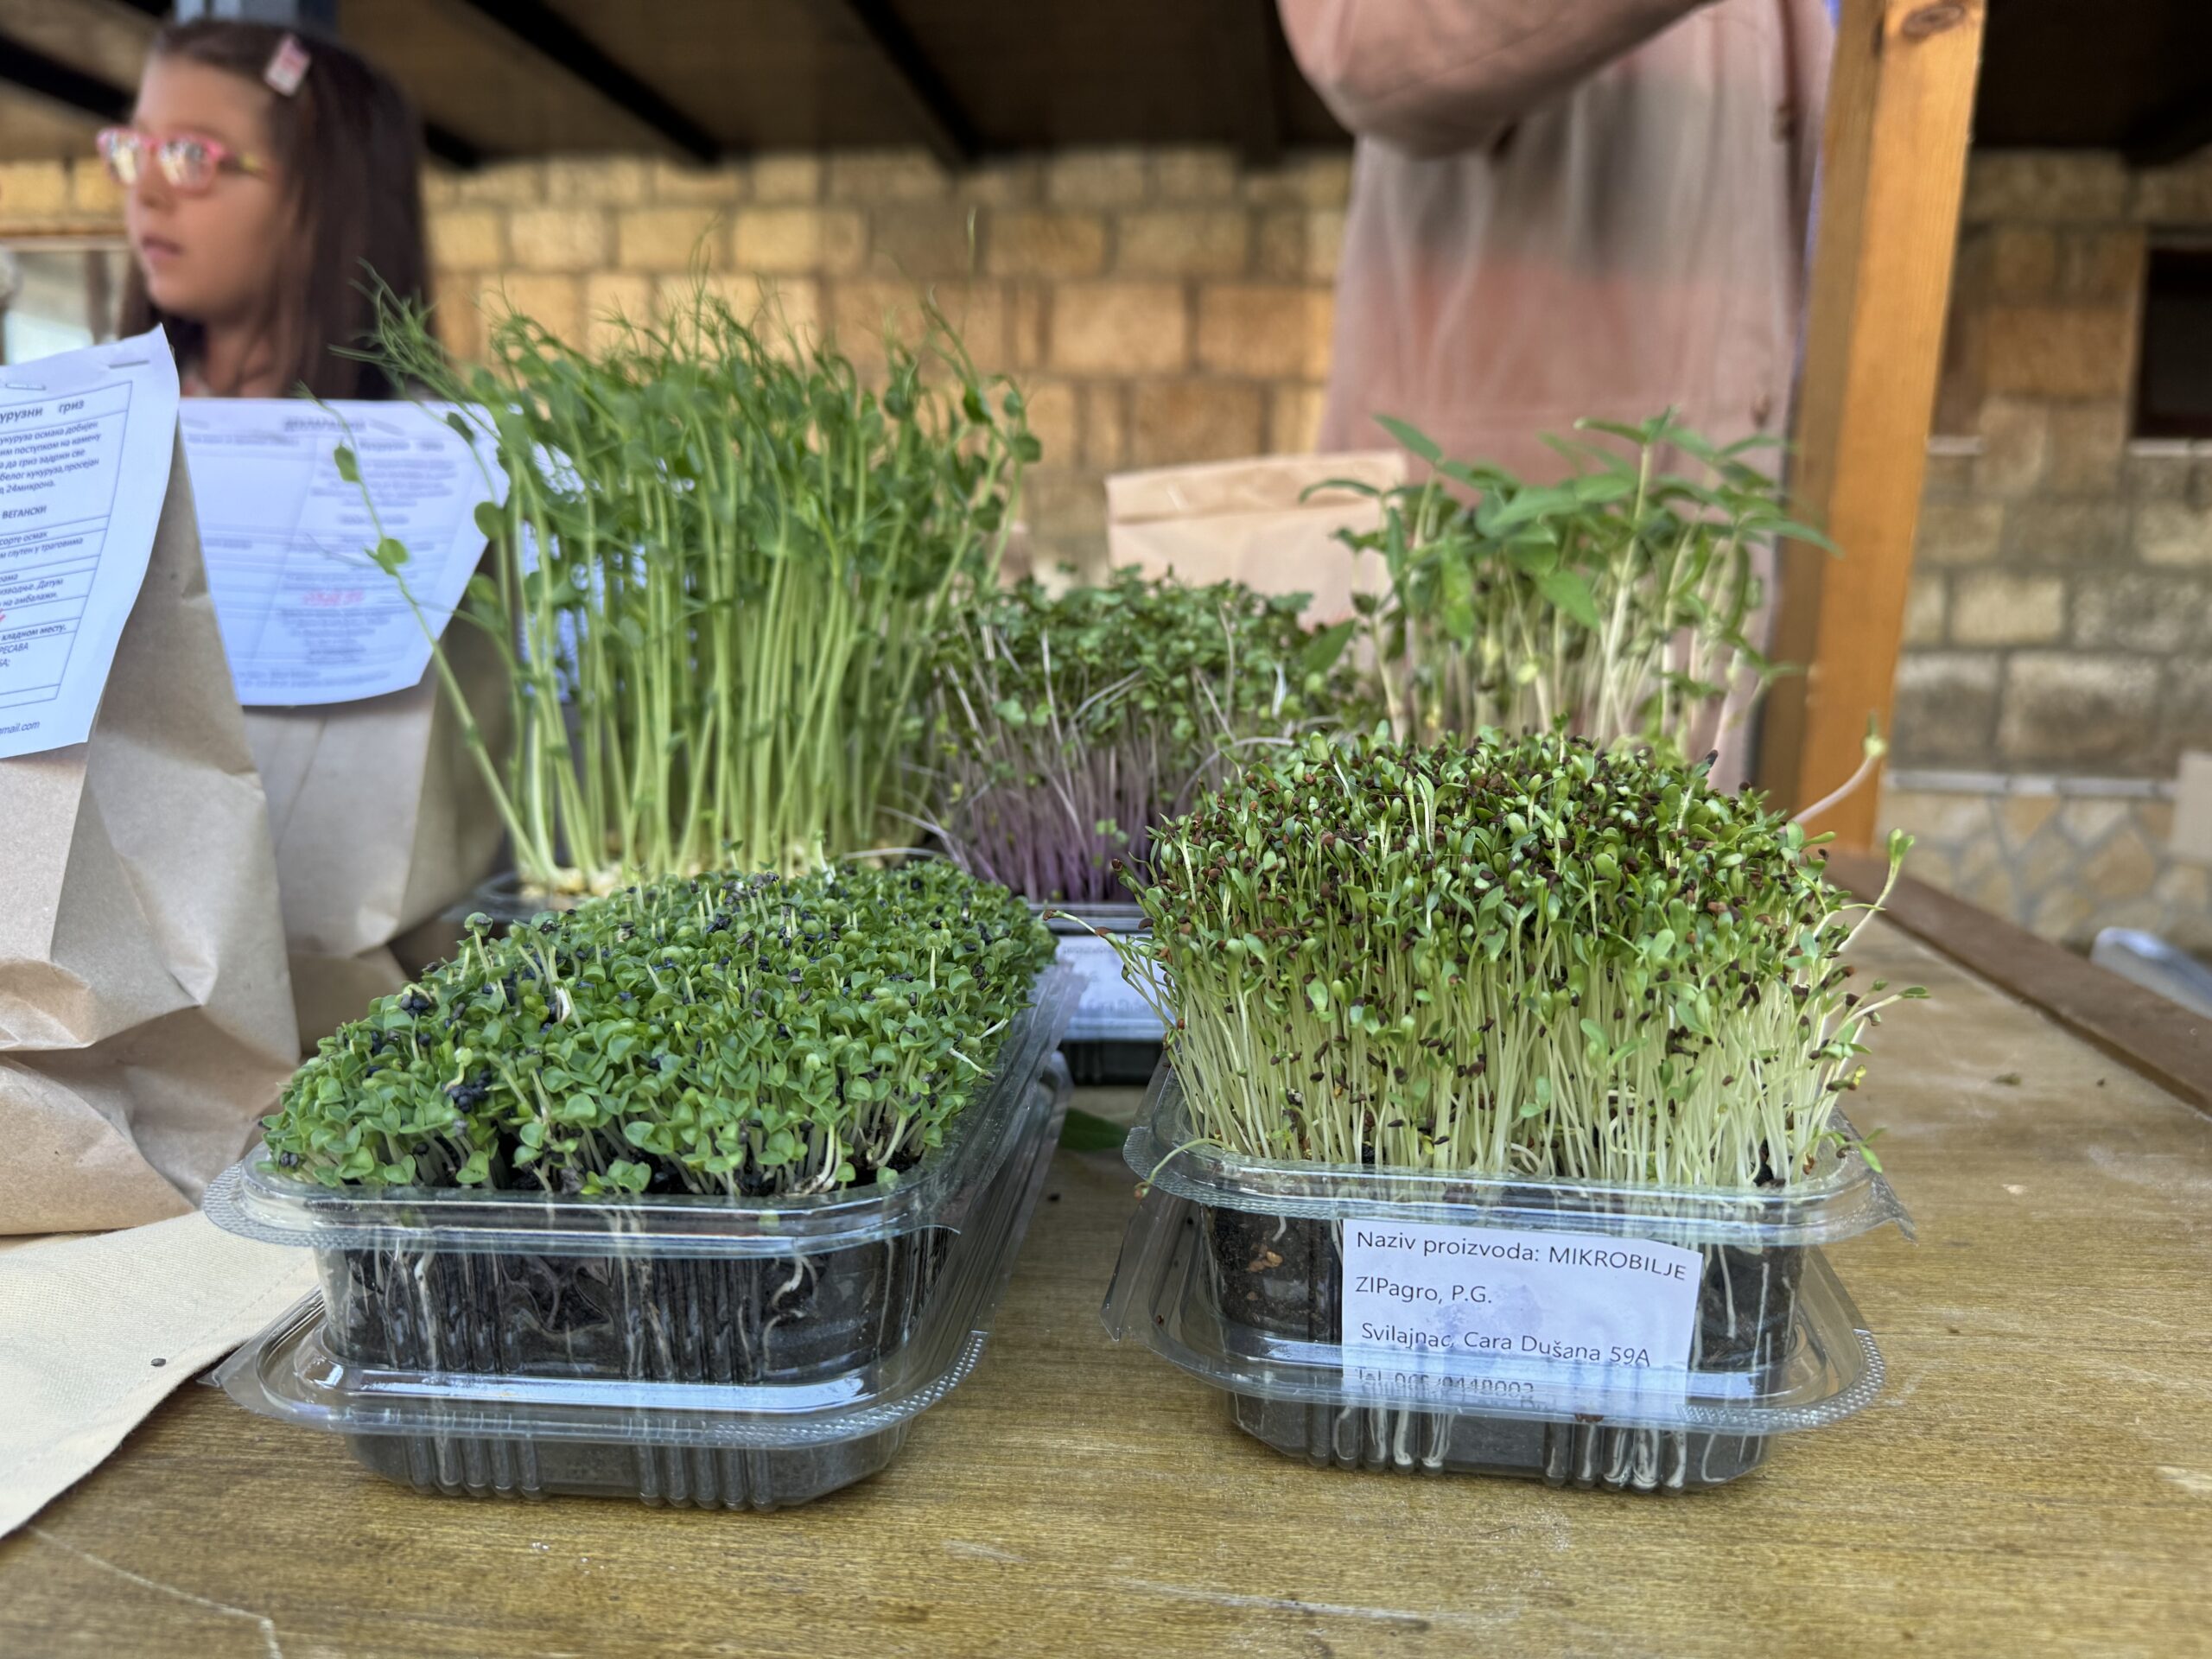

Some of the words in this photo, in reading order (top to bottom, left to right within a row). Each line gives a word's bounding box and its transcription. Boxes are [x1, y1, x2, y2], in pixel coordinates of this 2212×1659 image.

[59, 399, 85, 415] гриз
[15, 441, 60, 454] поступком
[5, 460, 17, 470] да
[2, 505, 48, 519] ВЕГАНСКИ
[1357, 1231, 1416, 1250] Naziv
[1424, 1237, 1540, 1262] proizvoda:
[1549, 1246, 1687, 1281] MIKROBILJE
[1355, 1276, 1442, 1304] ZIPagro,
[1452, 1285, 1492, 1303] P.G.
[1362, 1322, 1455, 1350] Svilajnac,
[1464, 1332, 1513, 1351] Cara
[1522, 1335, 1601, 1361] Dušana
[1610, 1346, 1650, 1367] 59A
